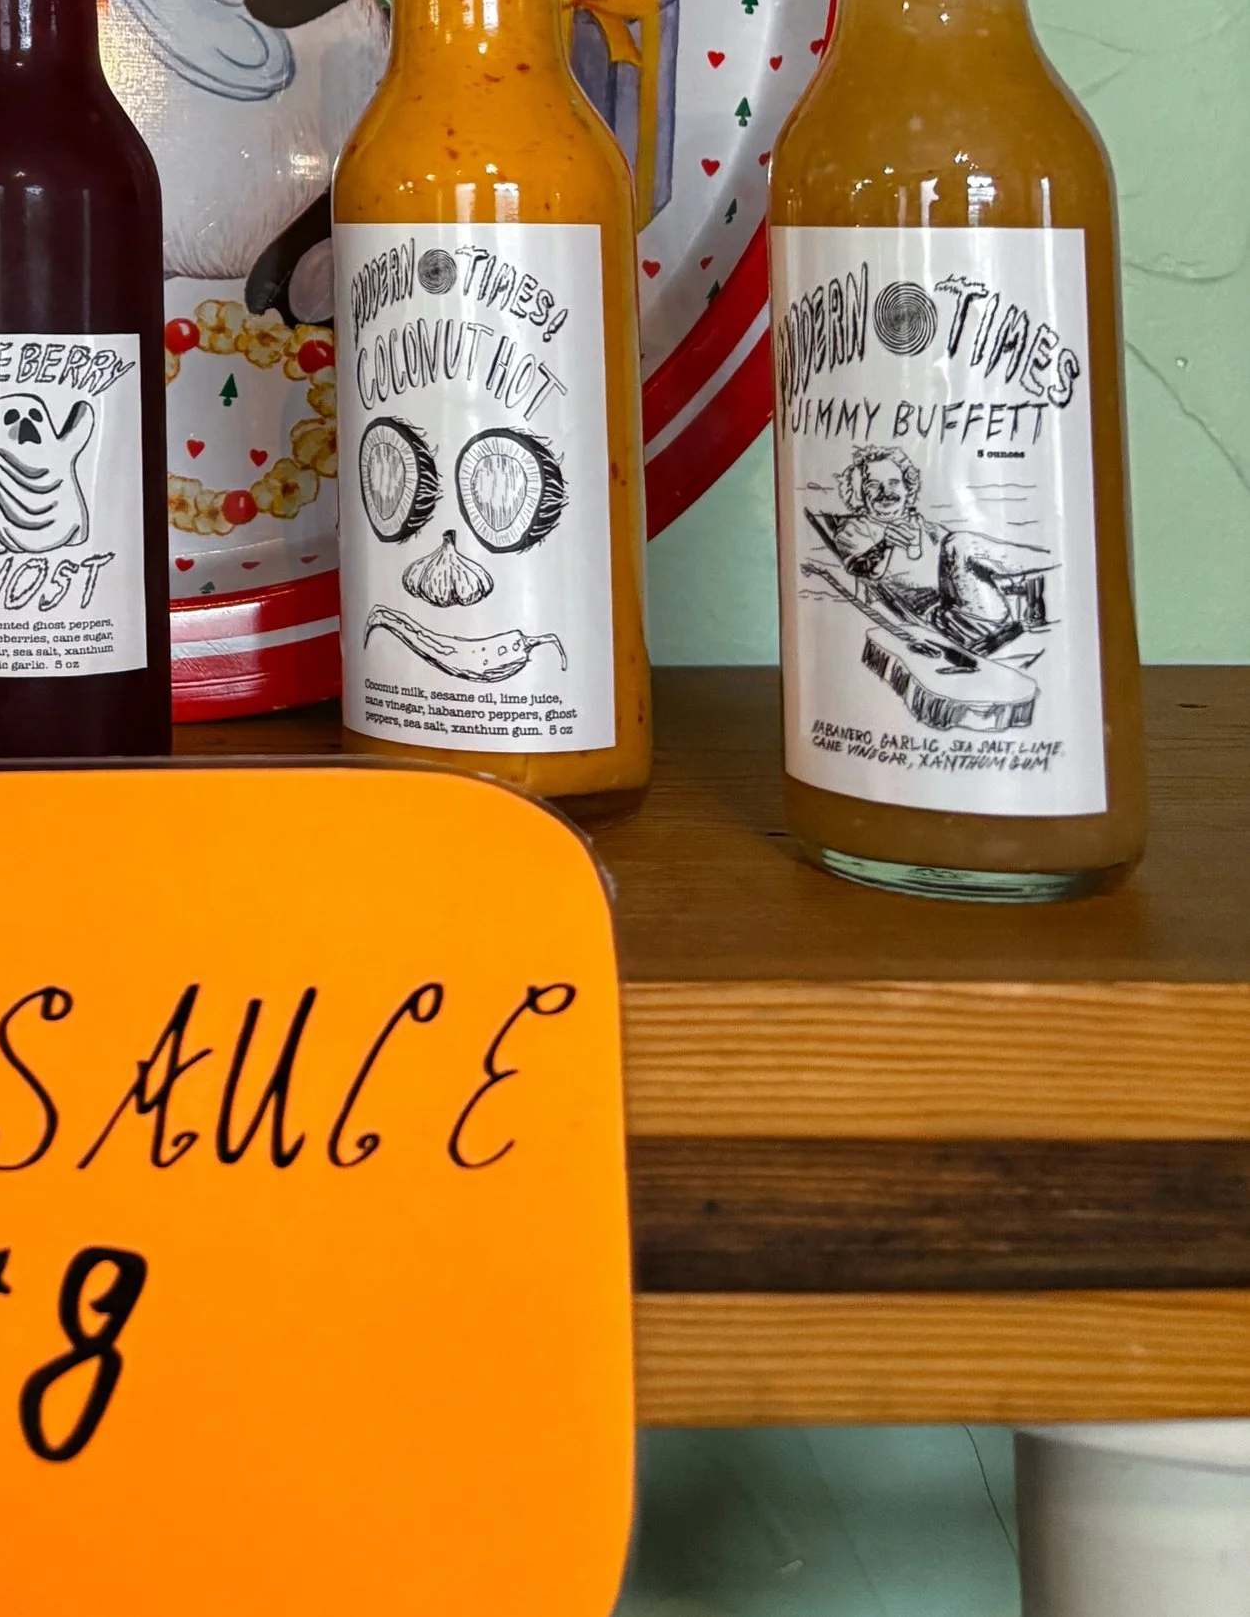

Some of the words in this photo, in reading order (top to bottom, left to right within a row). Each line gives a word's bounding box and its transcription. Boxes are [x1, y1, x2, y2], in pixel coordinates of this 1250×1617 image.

[350, 237, 416, 350] MODERN
[454, 245, 569, 343] TIMES!
[776, 261, 868, 443] MODERN
[933, 274, 1081, 409] TIMES
[356, 317, 495, 411] COCONUT
[485, 335, 569, 422] HOT
[791, 397, 881, 441] JIMMY
[892, 398, 1050, 445] BUFFETT
[976, 450, 984, 459] 5
[986, 450, 1026, 459] ounces
[32, 620, 67, 632] ghost
[68, 618, 114, 631] peppers,
[52, 635, 81, 643] cane
[82, 631, 114, 642] sugar,
[12, 648, 34, 657] sea
[35, 646, 62, 658] salt,
[64, 644, 114, 656] xanthum
[10, 659, 49, 672] garlic.
[54, 659, 63, 669] 5
[65, 661, 80, 669] oz
[364, 678, 400, 696] Coconut
[400, 686, 428, 700] milk,
[430, 690, 475, 703] sesame
[477, 692, 497, 706] oil,
[499, 692, 528, 704] lime
[528, 693, 563, 707] juice,
[365, 694, 384, 707] cane
[385, 698, 426, 715] vinegar,
[427, 704, 486, 719] habanero
[488, 708, 543, 722] peppers,
[544, 708, 578, 721] ghost
[365, 710, 401, 728] peppers,
[403, 718, 422, 730] sea
[423, 720, 449, 734] salt,
[450, 724, 509, 736] xanthum
[548, 724, 558, 736] 5
[559, 725, 574, 735] oz
[812, 735, 843, 752] CANE
